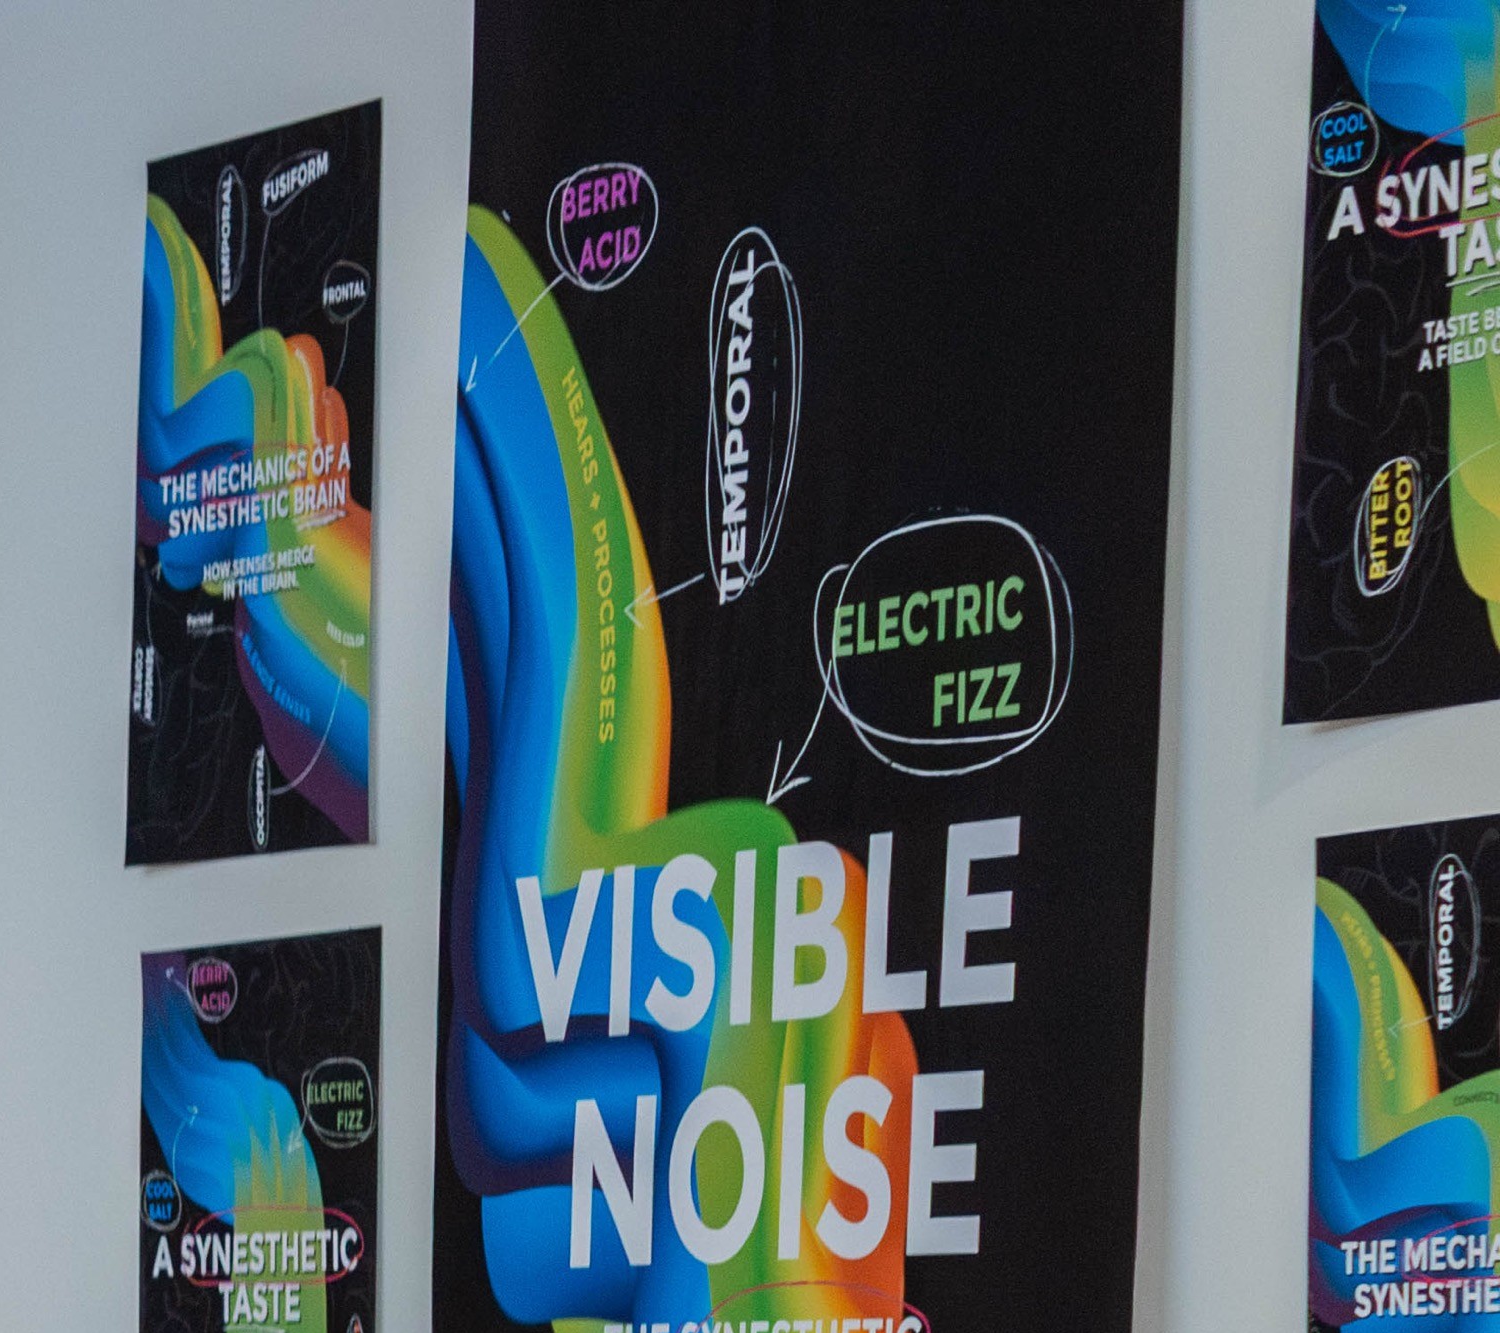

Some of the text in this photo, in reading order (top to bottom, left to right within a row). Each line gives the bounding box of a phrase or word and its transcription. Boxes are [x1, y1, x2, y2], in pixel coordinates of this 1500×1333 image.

[1321, 112, 1368, 140] COOL
[263, 151, 329, 207] FUSIFORM
[1323, 141, 1365, 168] SALT
[562, 167, 643, 224] BERRY
[1327, 185, 1365, 241] A
[576, 225, 642, 275] ACID
[1440, 219, 1500, 278] TA
[323, 280, 367, 306] FRONTAL
[1418, 348, 1433, 372] A
[1435, 336, 1488, 368] FIELD
[1423, 312, 1479, 344] TASTE
[720, 250, 756, 605] TEMPORAL
[160, 446, 351, 505] THE MECHANICS OF A
[1393, 459, 1413, 547] ROOT
[169, 479, 346, 538] SYNESTHETIC BRAIN
[1368, 470, 1390, 581] BITTER
[203, 546, 315, 585] HOW SENSES MERGE
[560, 366, 600, 486] HEARS
[590, 518, 616, 743] PROCESSES
[223, 581, 236, 600] IN
[238, 577, 259, 598] THE
[834, 576, 1026, 658] ELECTRIC
[932, 662, 1022, 728] FIZZ
[515, 816, 1021, 1043] VISIBLE
[1437, 864, 1455, 1031] TEMPORAL
[308, 1081, 364, 1106] ELECTRIC
[336, 1109, 363, 1132] FIZZ
[570, 1069, 985, 1268] NOISE
[152, 1227, 358, 1278] A SYNESTHETIC
[1341, 1239, 1396, 1276] THE
[219, 1282, 301, 1323] TASTE
[1354, 1278, 1500, 1318] SYNESTHE
